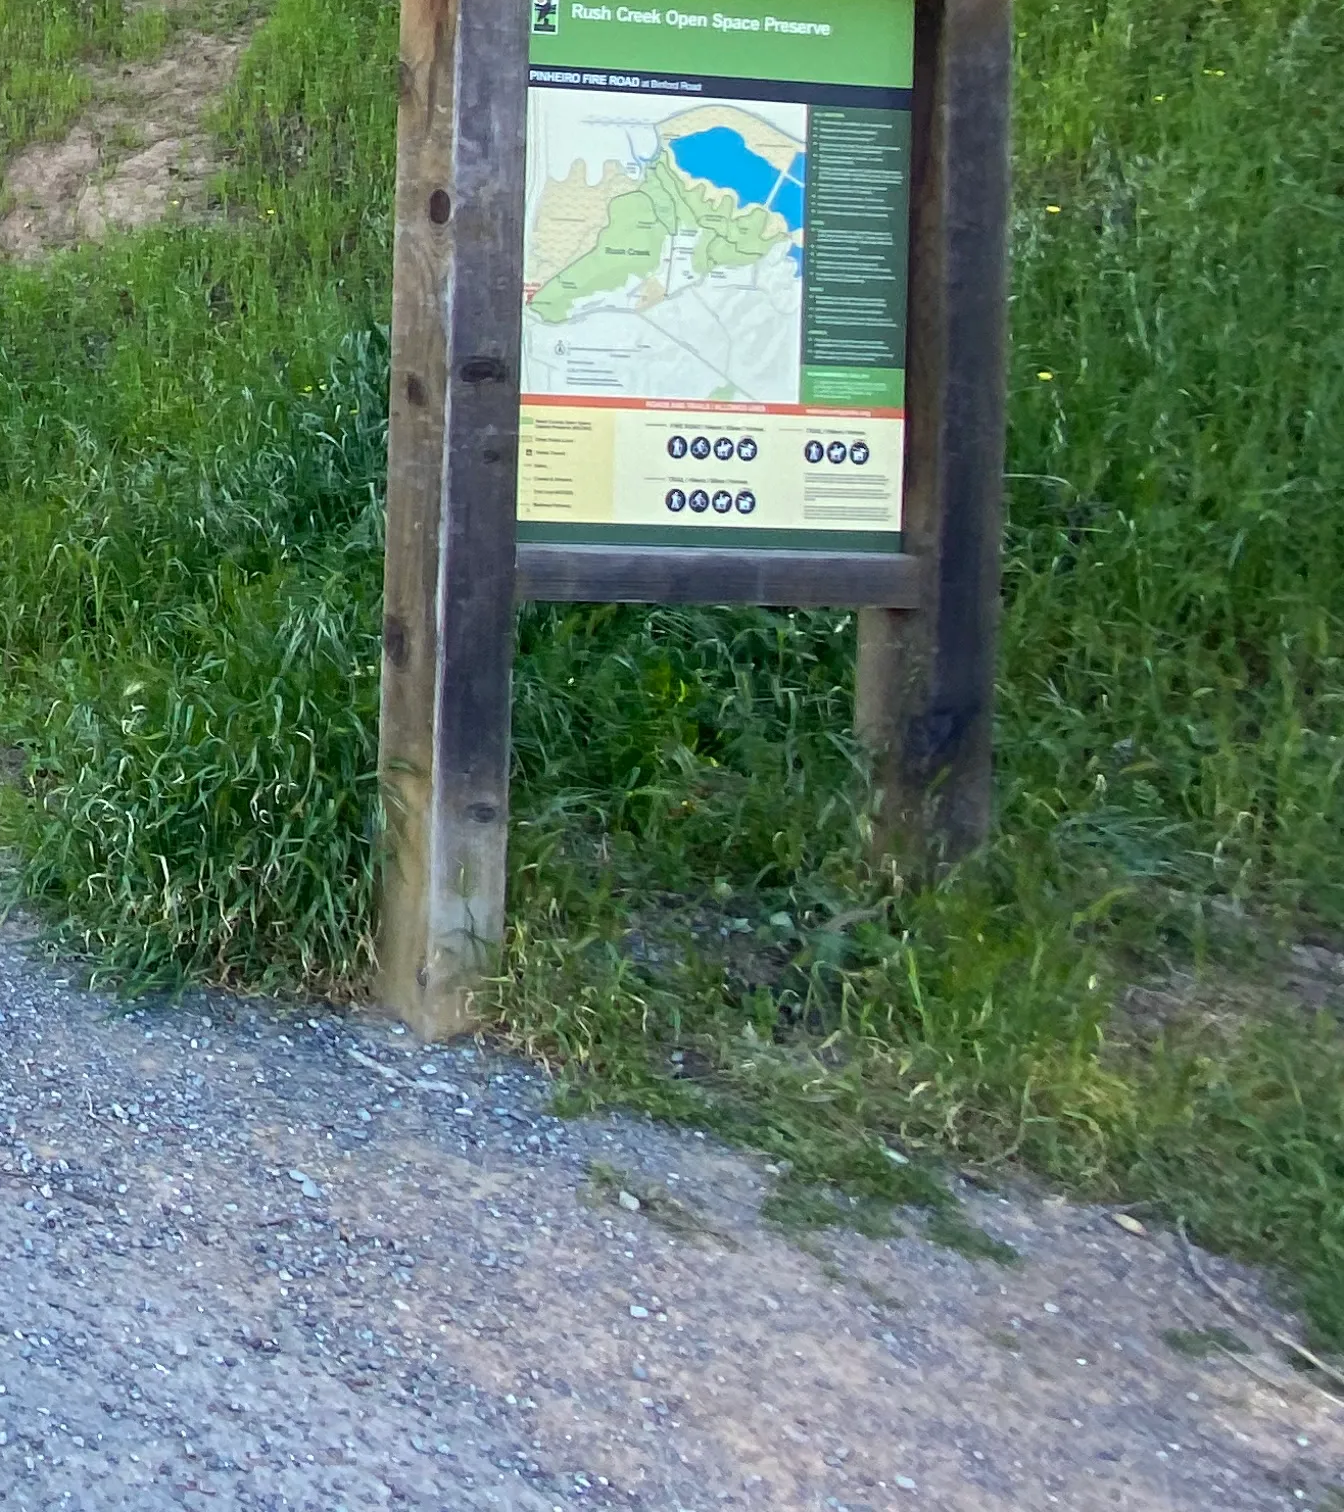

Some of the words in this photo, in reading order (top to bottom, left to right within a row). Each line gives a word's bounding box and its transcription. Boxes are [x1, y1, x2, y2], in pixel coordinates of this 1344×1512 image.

[571, 2, 612, 22] Rush
[616, 6, 661, 25] Creek
[665, 9, 708, 29] Open
[712, 12, 760, 33] Space
[764, 16, 831, 36] Preserve
[529, 69, 581, 84] PINHEIRO
[582, 73, 608, 86] FIRE
[608, 75, 640, 88] ROAD
